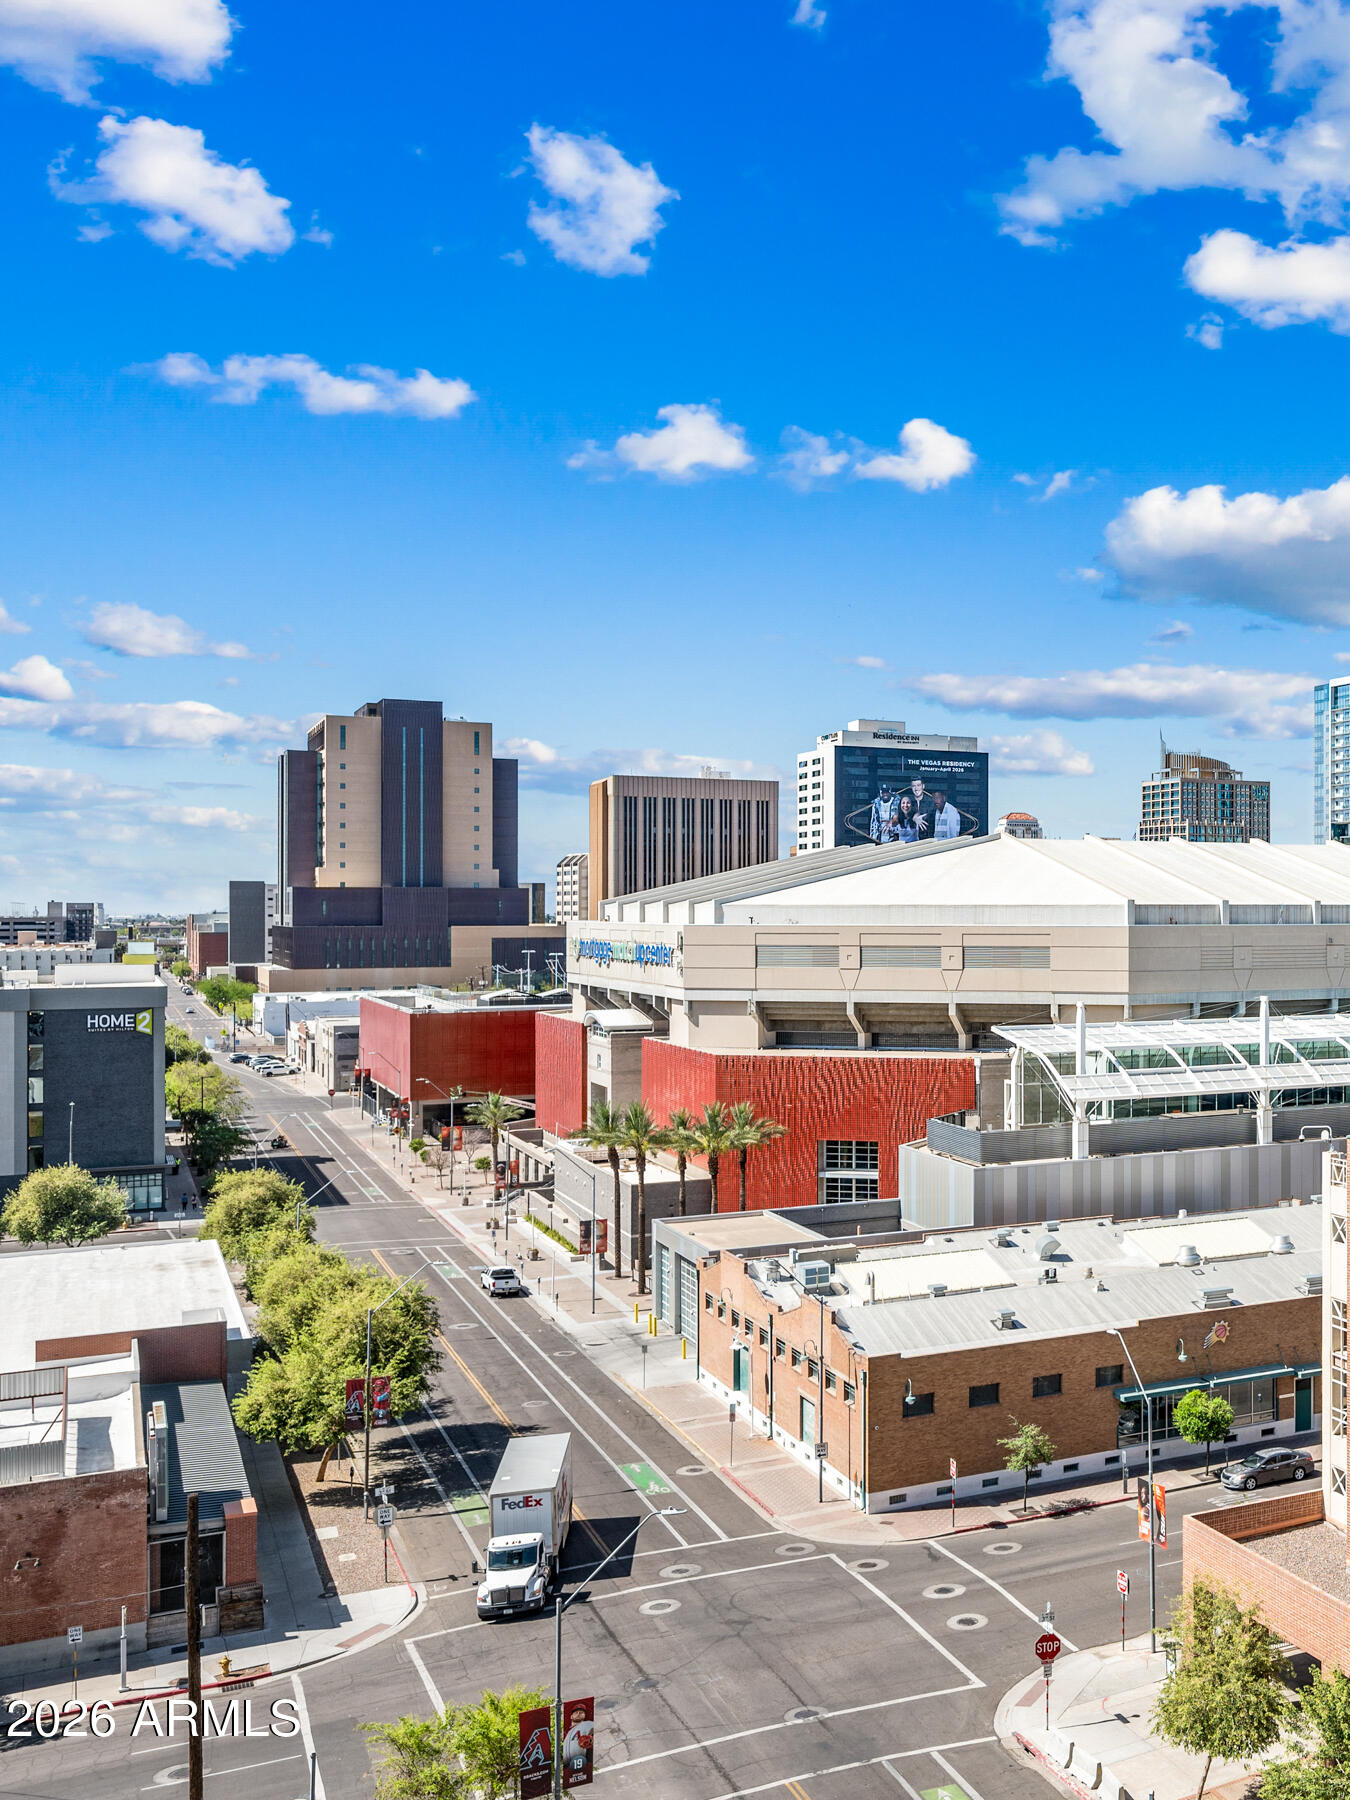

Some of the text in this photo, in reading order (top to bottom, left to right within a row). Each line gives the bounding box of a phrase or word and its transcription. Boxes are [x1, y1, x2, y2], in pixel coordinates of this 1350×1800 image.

[873, 732, 910, 740] Residence
[87, 1012, 151, 1033] HOME 2
[501, 1495, 544, 1511] FedEx
[1036, 1641, 1060, 1654] STOP
[574, 1758, 583, 1769] 19
